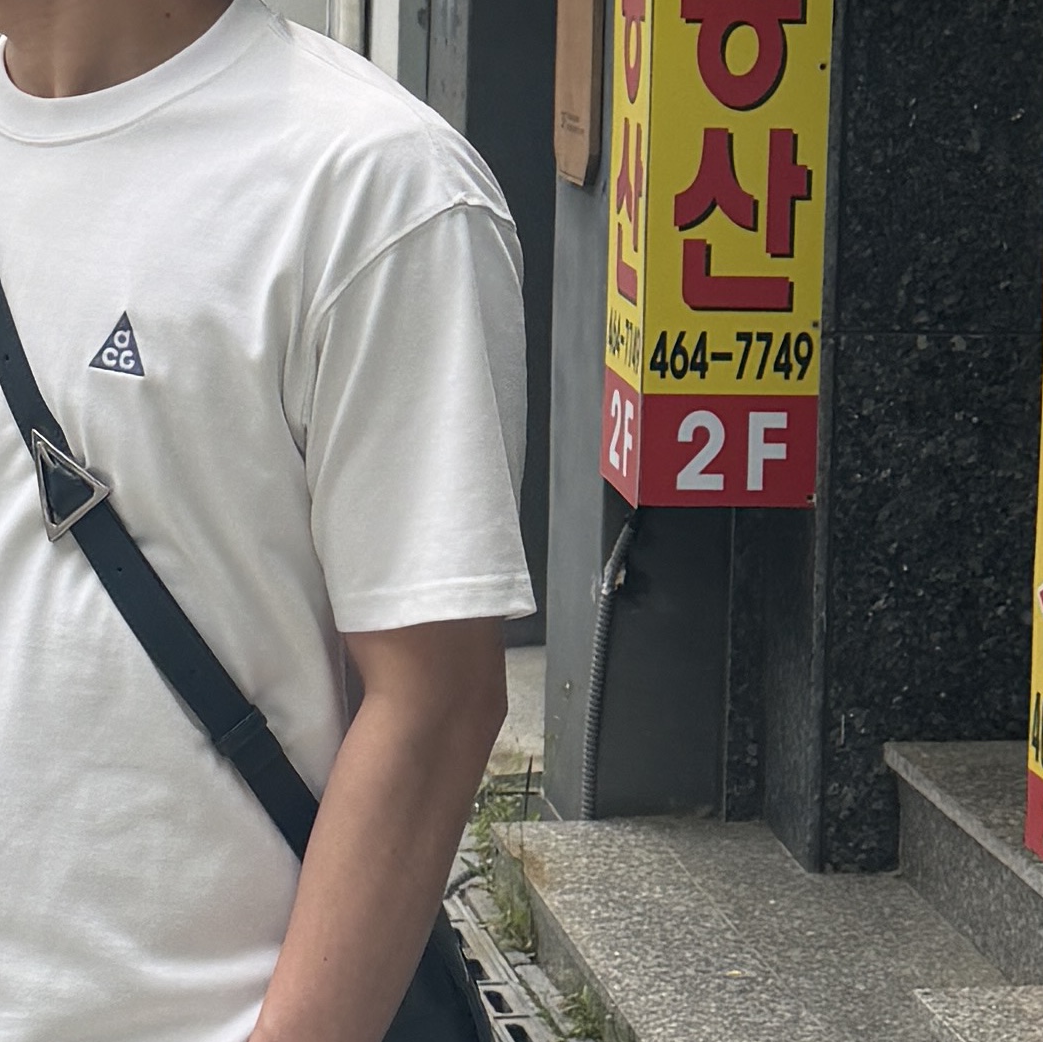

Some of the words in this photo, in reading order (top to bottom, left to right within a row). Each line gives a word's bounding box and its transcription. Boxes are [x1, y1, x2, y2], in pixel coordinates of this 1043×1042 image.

[649, 331, 814, 380] 464-7749
[608, 388, 635, 478] 2F
[676, 410, 788, 491] 2F
